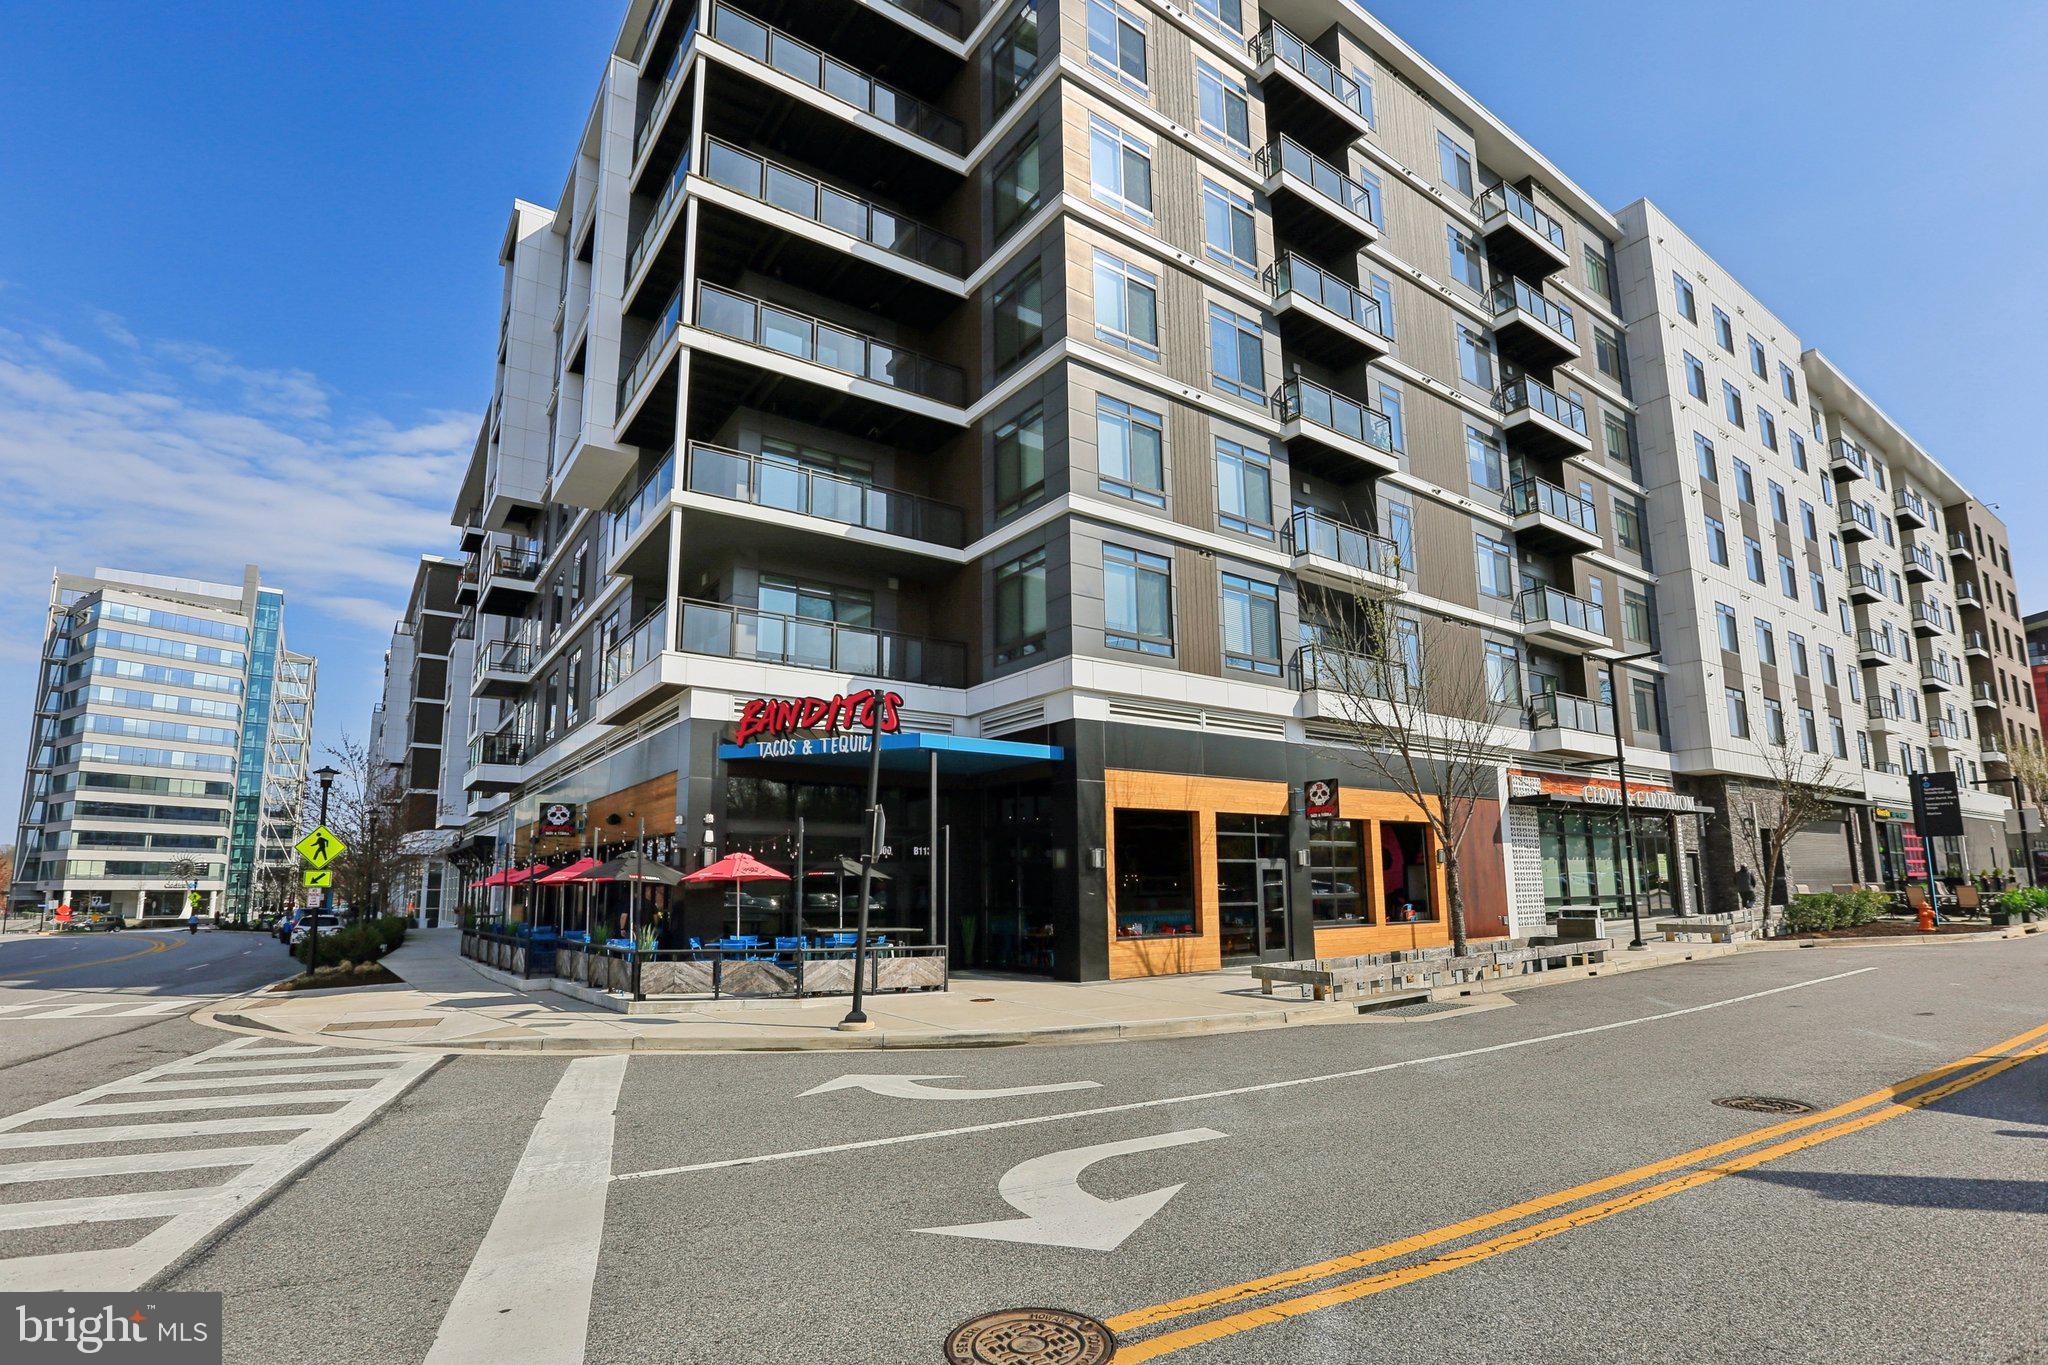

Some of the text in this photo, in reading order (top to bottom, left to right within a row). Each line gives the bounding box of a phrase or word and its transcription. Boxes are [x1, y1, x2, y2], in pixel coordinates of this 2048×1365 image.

[736, 689, 904, 748] BANDITOS
[757, 739, 797, 758] TACOS
[802, 739, 813, 755] &
[1583, 785, 1623, 805] CLOVE
[1636, 791, 1696, 811] CARDAMOM
